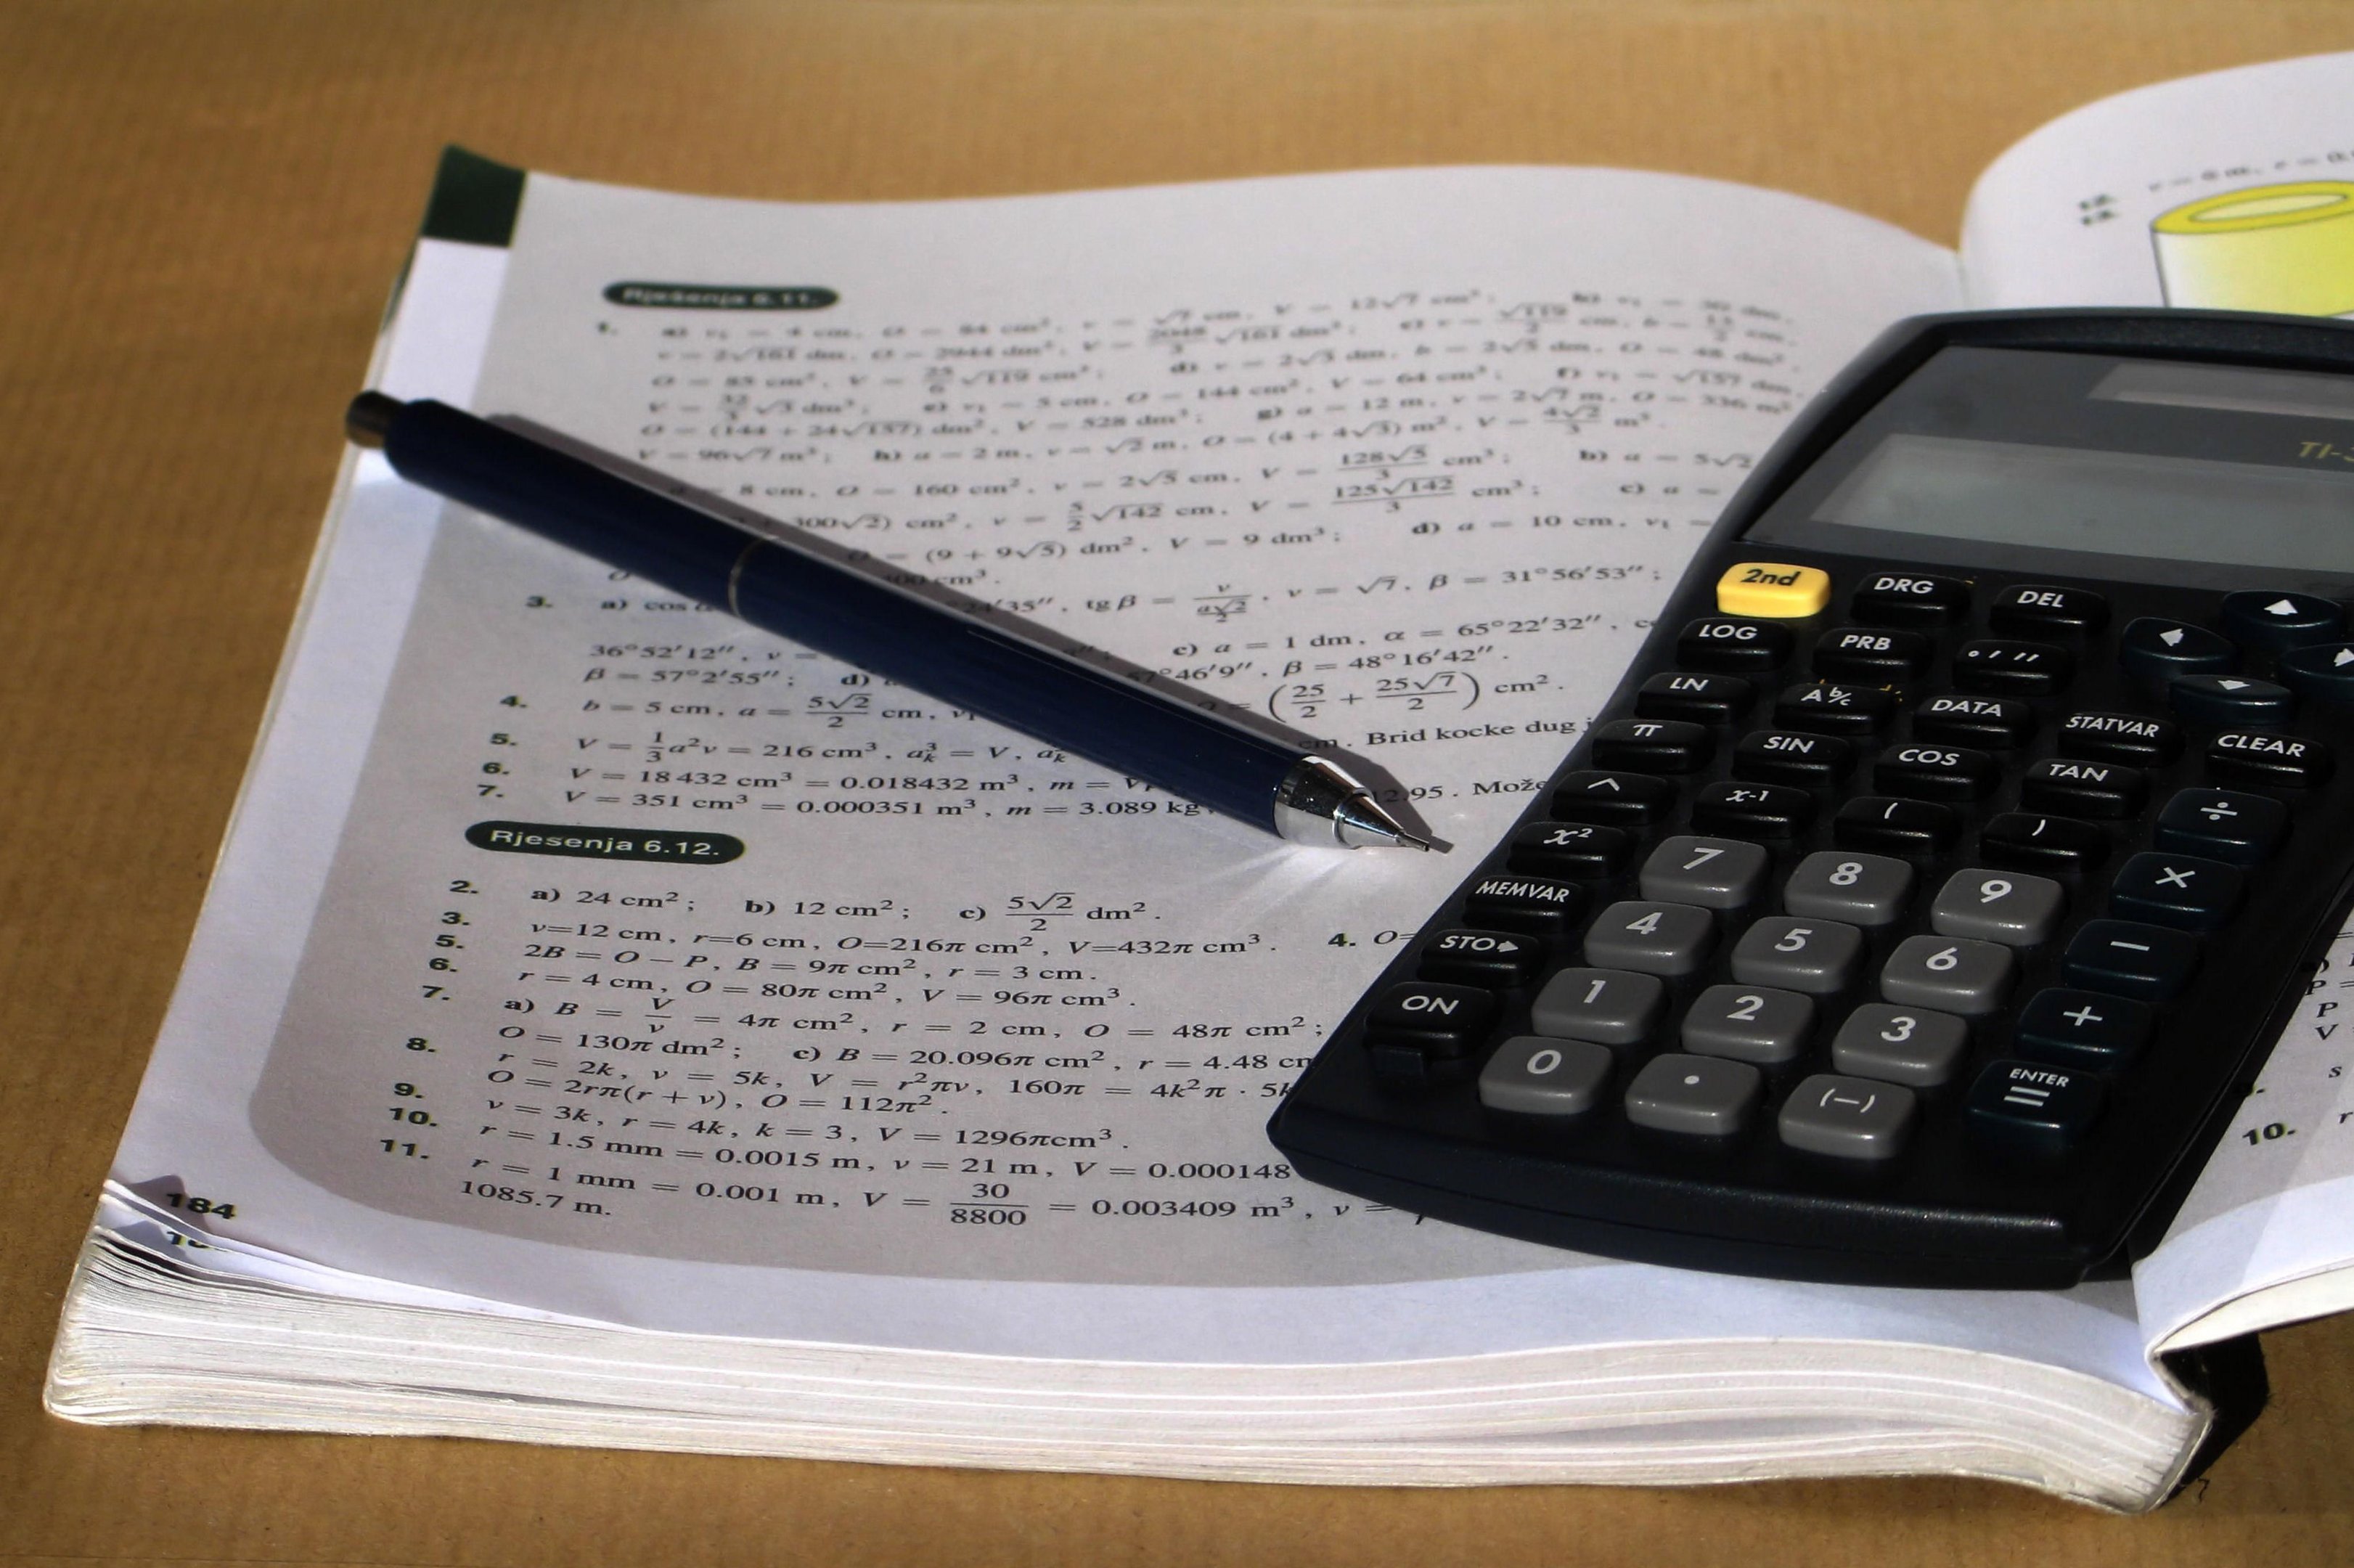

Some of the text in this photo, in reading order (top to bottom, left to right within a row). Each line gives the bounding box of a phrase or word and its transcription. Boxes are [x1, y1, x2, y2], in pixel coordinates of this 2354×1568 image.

[1741, 569, 1802, 586] 2nd
[1874, 577, 1934, 594] DRG
[600, 599, 628, 611] a)
[643, 602, 687, 612] cos
[2016, 590, 2064, 608] DEL
[1699, 624, 1757, 640] LOG
[1841, 635, 1892, 650] PRB
[1172, 643, 1198, 656] c)
[841, 674, 870, 686] d)
[1670, 677, 1709, 691] LN
[499, 695, 527, 709] 4.
[1932, 699, 2002, 717] DATA
[1367, 728, 1426, 746] Brid
[1436, 724, 1515, 740] kocke
[1525, 720, 1576, 735] dug
[1632, 724, 1663, 737] π
[2066, 716, 2160, 738] STATVAR
[490, 732, 517, 746] 5.
[763, 744, 814, 758] 216
[1763, 736, 1815, 754] SIN
[2217, 734, 2305, 756] CLEAR
[1898, 749, 1960, 767] COS
[482, 761, 510, 775] 6.
[840, 777, 969, 791] 0.018432
[2048, 764, 2109, 782] TAN
[477, 784, 504, 798] 7.
[632, 793, 679, 807] 351
[796, 801, 922, 814] 0.000351
[1079, 801, 1157, 815] 3.089
[489, 829, 719, 856] Rjesenja 6.12.
[1683, 847, 1725, 870] 7
[1828, 862, 1864, 886] 8
[449, 880, 479, 894] 2.
[531, 888, 560, 903] a)
[576, 891, 611, 905] 24
[745, 899, 775, 915] b)
[794, 902, 825, 915] 12
[959, 906, 986, 922] c)
[1476, 881, 1571, 903] MEMVAR
[1979, 879, 2013, 904] 9
[441, 911, 470, 926] 3.
[531, 923, 609, 938] v=12
[692, 933, 753, 947] r=6
[1328, 933, 1357, 947] 4.
[1626, 912, 1664, 935] 4
[1439, 936, 1495, 951] STO
[1775, 928, 1813, 952] 5
[435, 934, 465, 950] 5.
[524, 944, 566, 958] 2B
[809, 960, 849, 974] 9π
[1013, 965, 1029, 979] 3
[1925, 947, 1958, 971] 6
[428, 957, 458, 973] 6.
[581, 973, 600, 987] 4
[761, 983, 820, 998] 80π
[994, 990, 1053, 1005] 96π
[1583, 980, 1607, 1004] 1
[422, 985, 450, 1001] 7.
[504, 998, 535, 1014] a)
[737, 1013, 780, 1028] 4π
[969, 1021, 987, 1034] 2
[1172, 1024, 1233, 1039] 48π
[1402, 995, 1460, 1015] ON
[1727, 995, 1764, 1021] 2
[2316, 1002, 2339, 1018] P
[1880, 1017, 1916, 1042] 3
[2315, 1024, 2339, 1041] V
[577, 1034, 653, 1052] 130π
[793, 1046, 821, 1062] c)
[910, 1050, 1035, 1066] 20.096π
[1203, 1054, 1268, 1070] 4.48
[1526, 1049, 1562, 1075] 0
[406, 1037, 1086, 1095] 8. 2k, 5k, 160π
[2009, 1068, 2070, 1087] ENTER
[393, 1082, 424, 1099] 9.
[553, 1106, 604, 1127] 3k,
[687, 1120, 738, 1138] 4k,
[825, 1124, 857, 1143] 3,
[389, 1107, 1291, 1180] 10. 1.5 mm 0.0015 m, 21 m, 0.000148
[2242, 1122, 2296, 1146] 10.
[380, 1139, 430, 1160] 11.
[548, 1167, 560, 1182] 1
[576, 1174, 636, 1190] mm
[461, 1180, 611, 1216] 1085.7 m.
[695, 1183, 779, 1203] 0.001
[795, 1193, 839, 1208] m,
[972, 1183, 1010, 1199] 30
[166, 1193, 236, 1220] 184
[950, 1208, 1026, 1226] 8800
[1092, 1199, 1236, 1217] 0.003409
